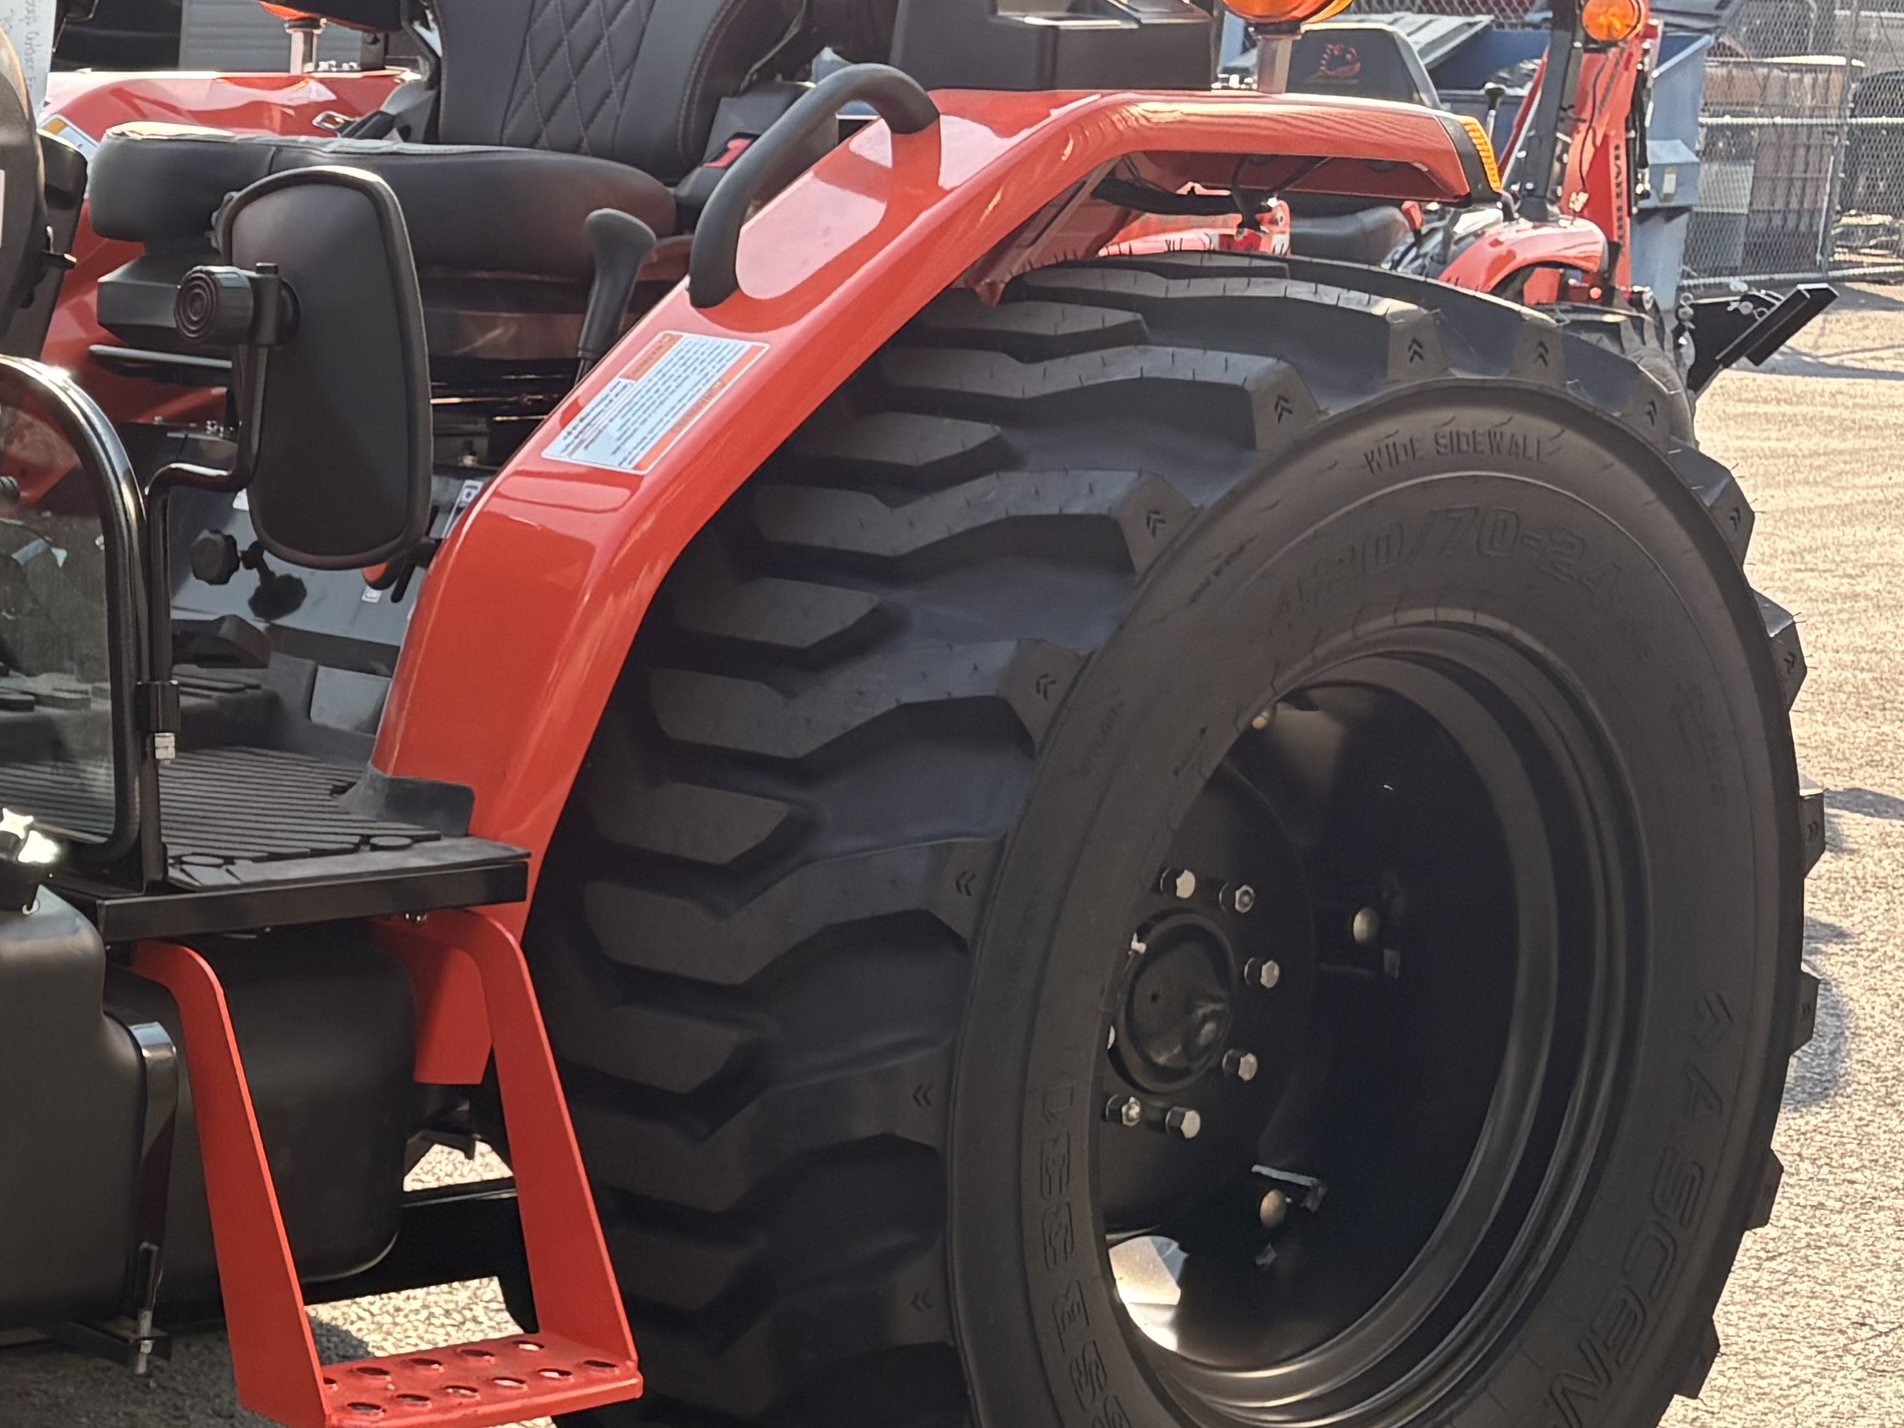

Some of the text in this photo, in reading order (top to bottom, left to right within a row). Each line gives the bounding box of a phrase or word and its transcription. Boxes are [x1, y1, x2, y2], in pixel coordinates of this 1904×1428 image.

[1363, 428, 1558, 476] WIDE SIDEWALL
[1037, 1082, 1078, 1272] 331
